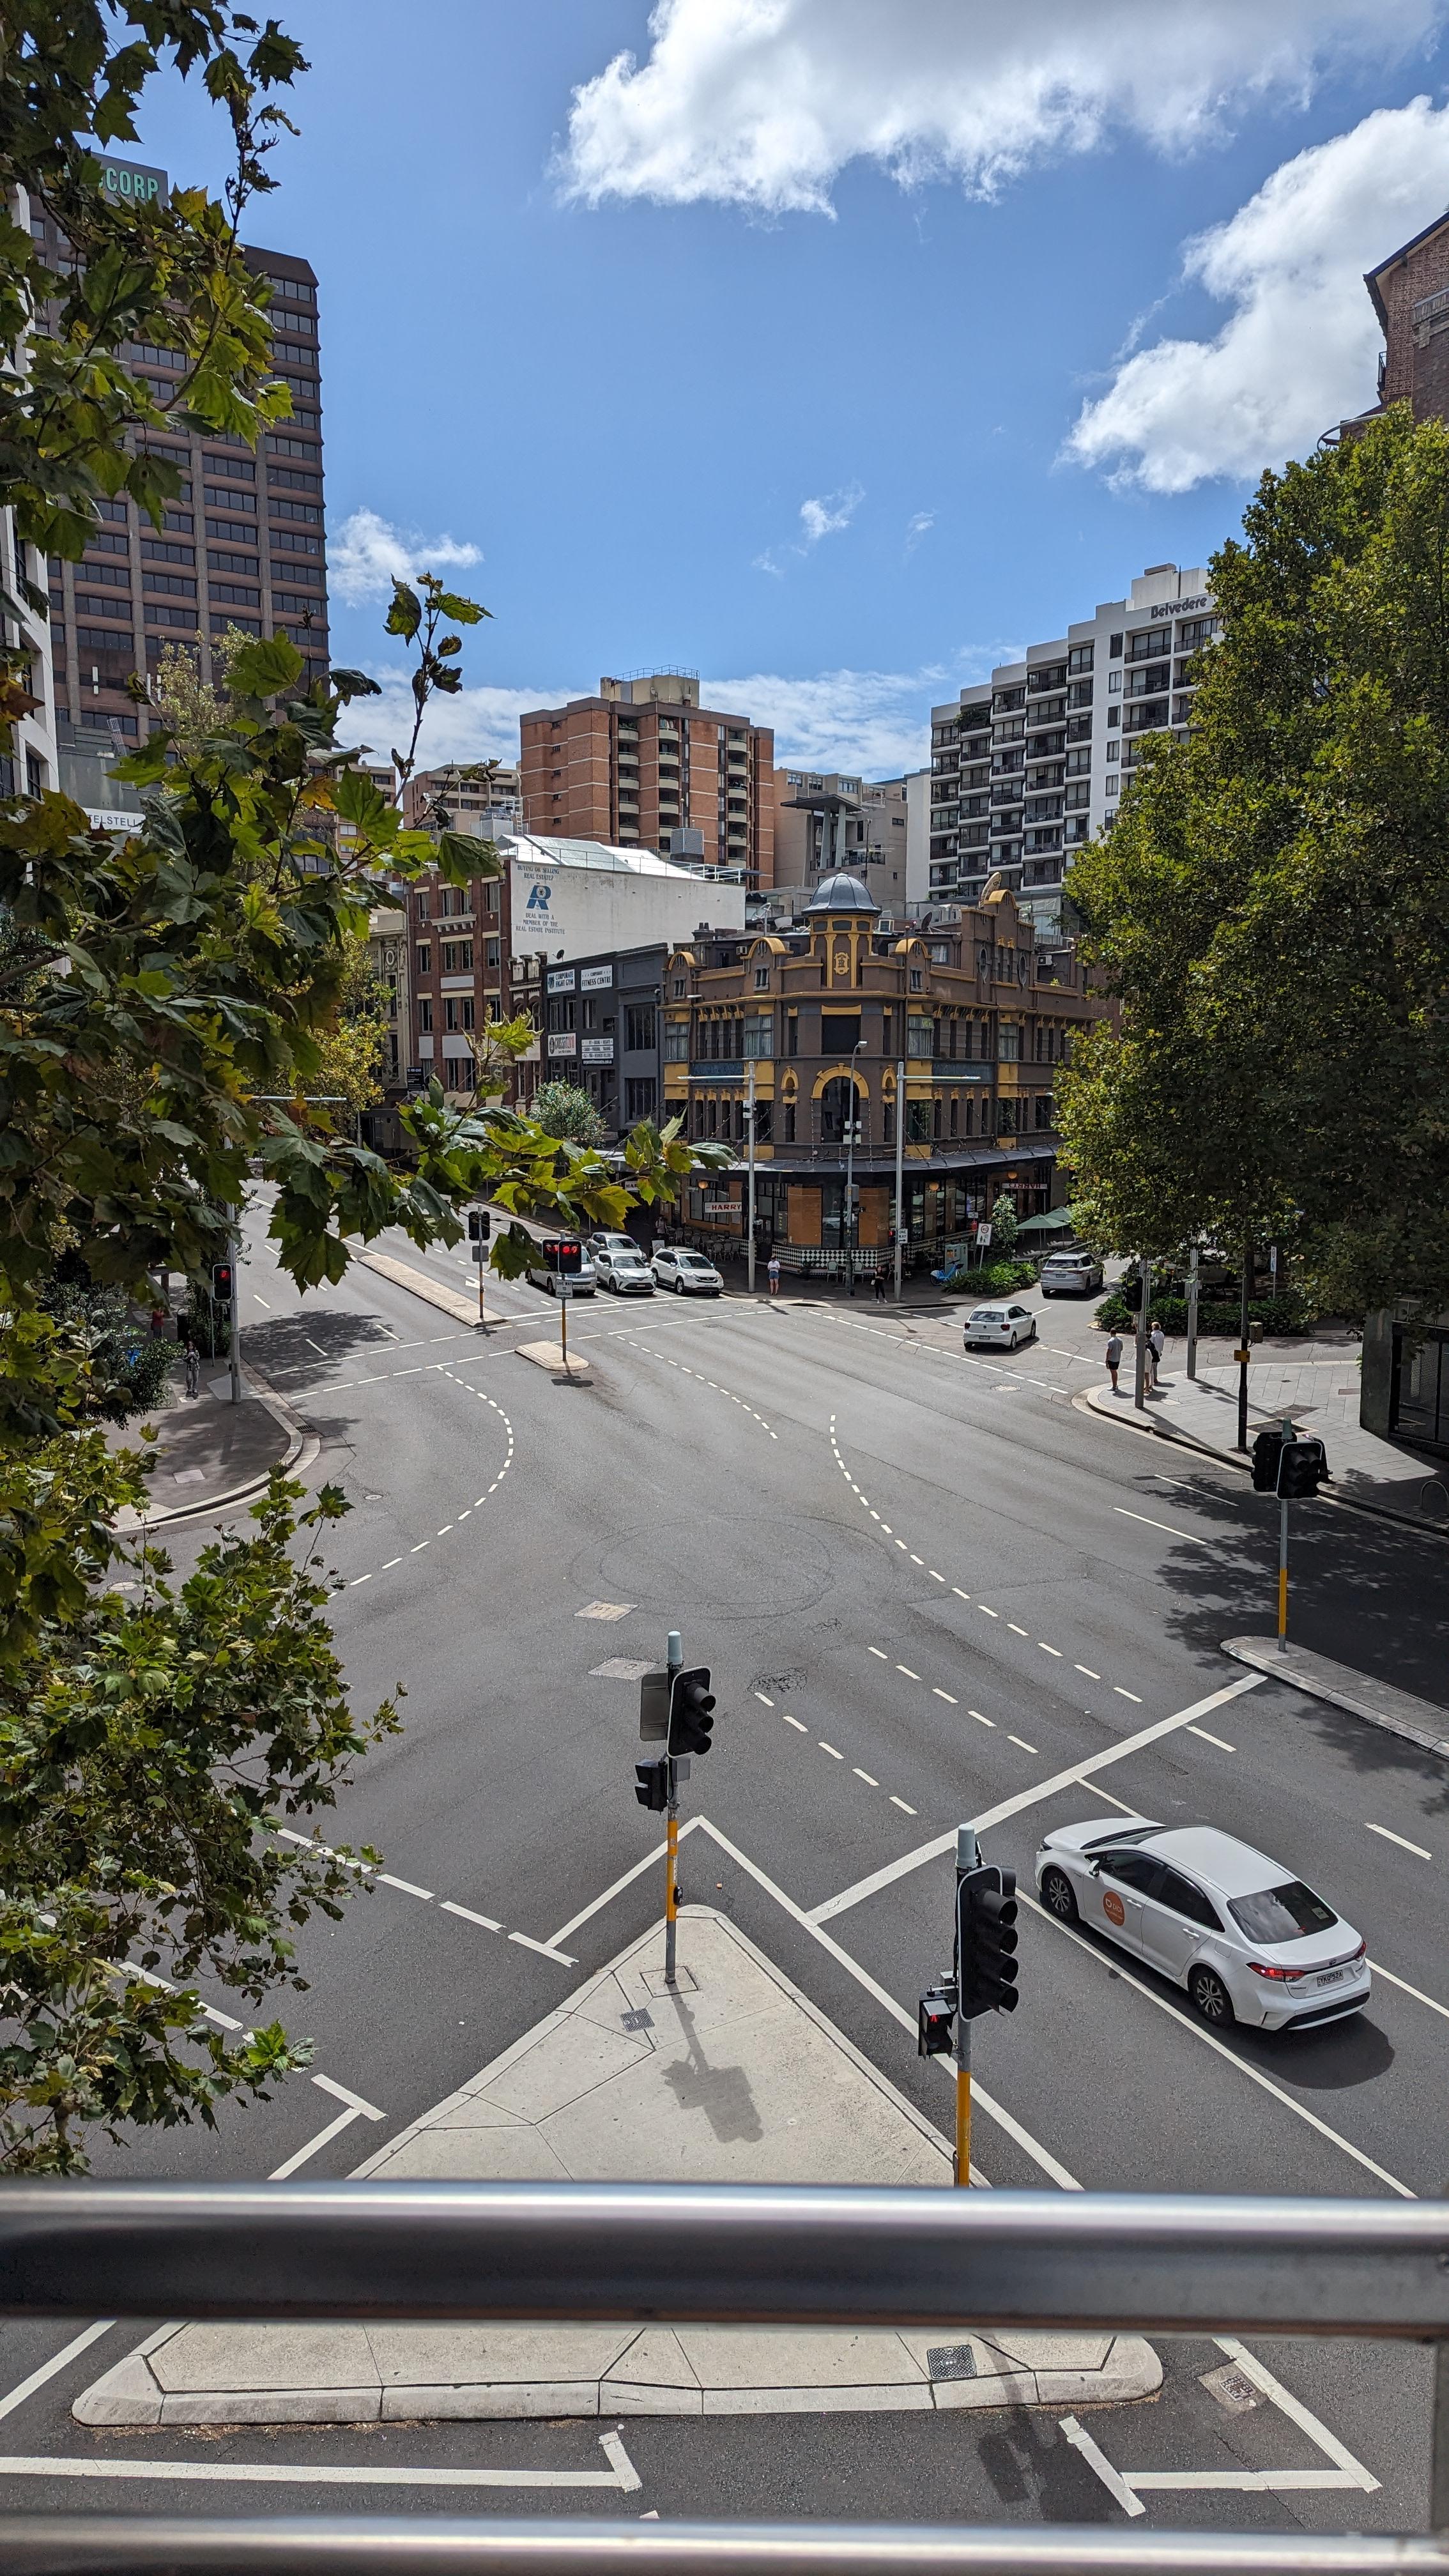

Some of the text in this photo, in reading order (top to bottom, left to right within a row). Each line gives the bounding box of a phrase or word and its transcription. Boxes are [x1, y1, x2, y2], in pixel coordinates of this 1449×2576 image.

[99, 167, 158, 200] CORP
[1150, 597, 1208, 619] Belvedere
[555, 971, 574, 981] CORPORATE
[581, 976, 611, 987] FITNESS CENTRE
[555, 979, 565, 988] FIGHT
